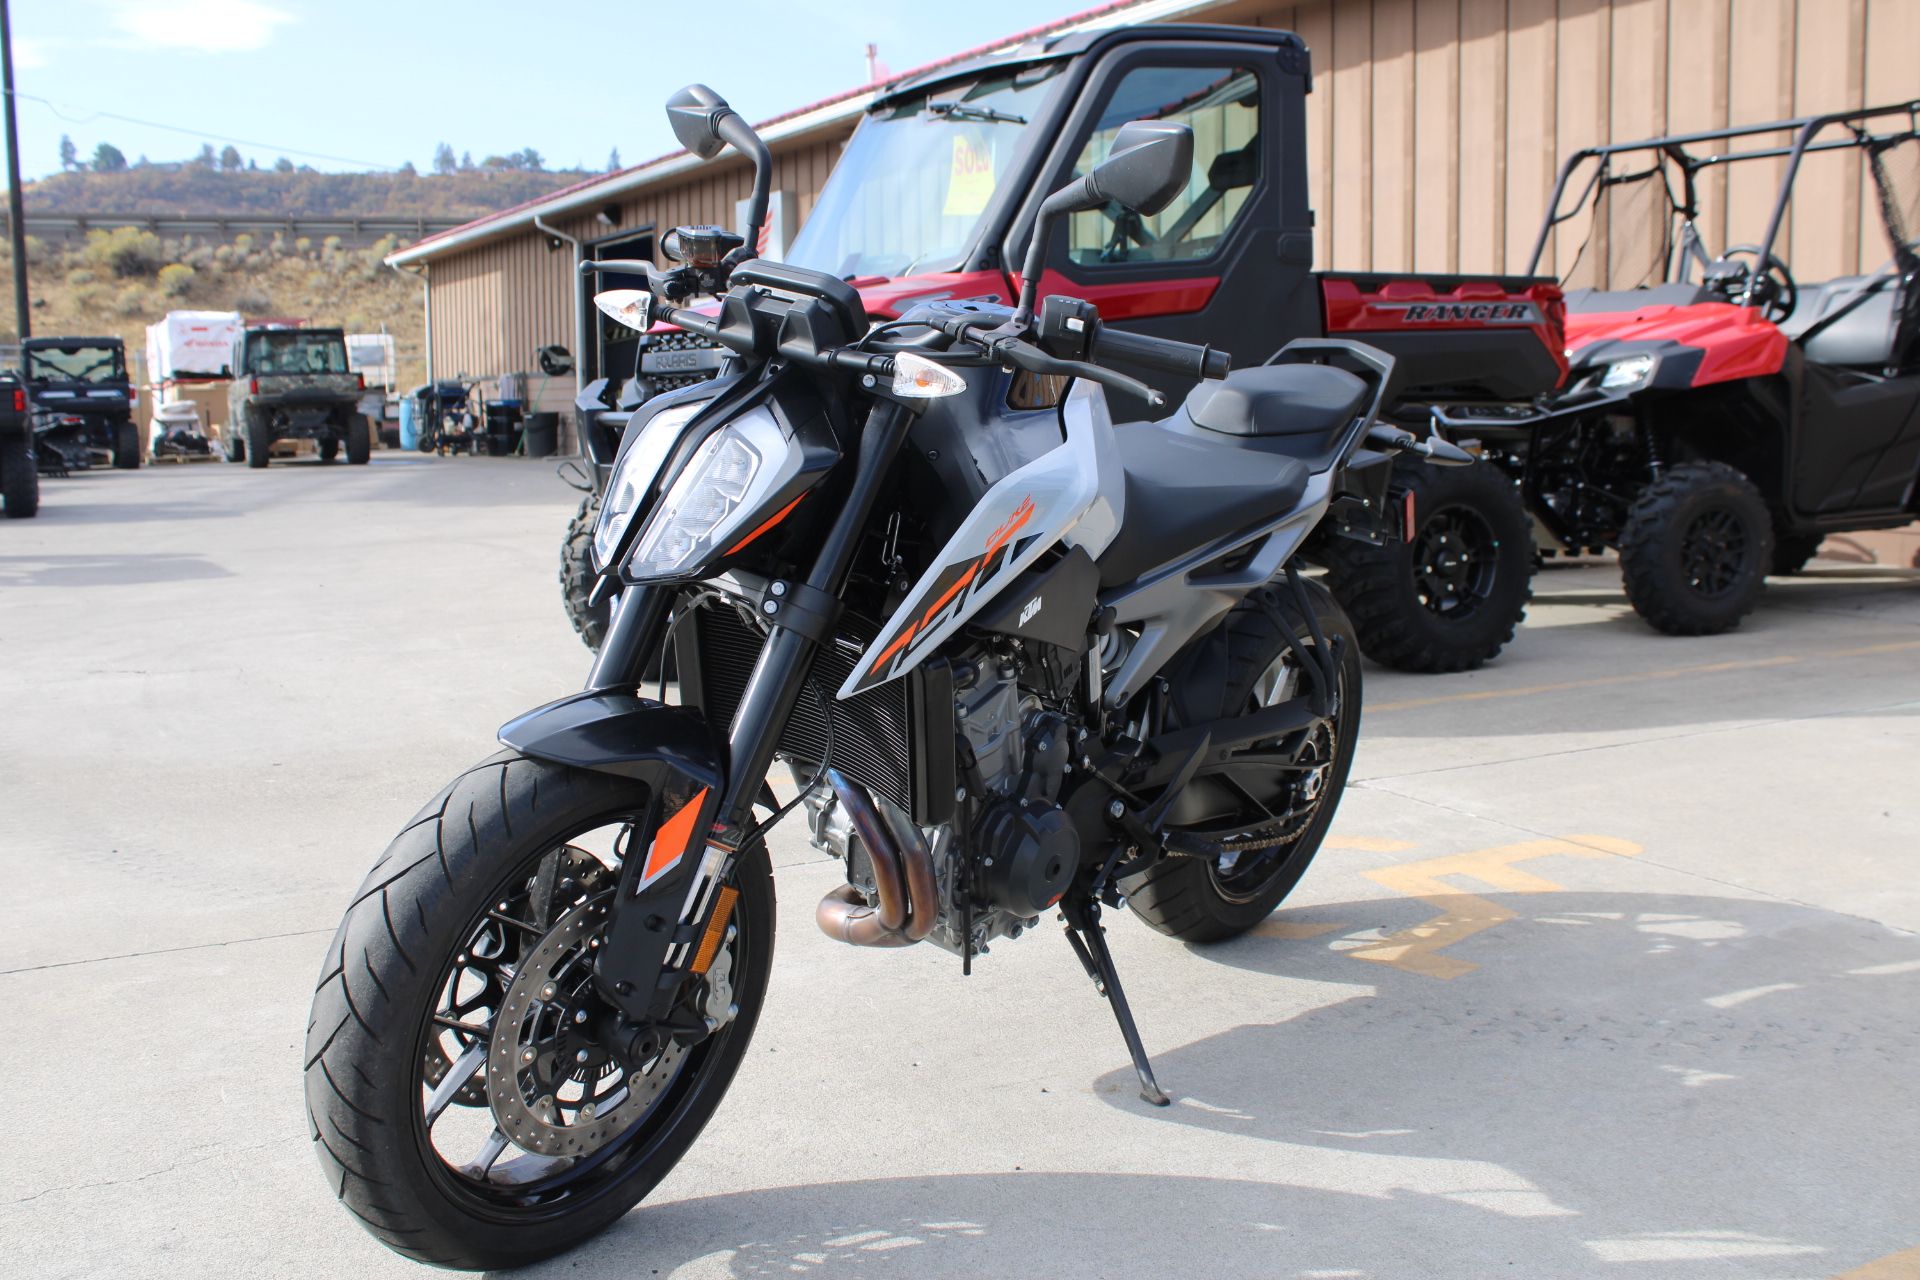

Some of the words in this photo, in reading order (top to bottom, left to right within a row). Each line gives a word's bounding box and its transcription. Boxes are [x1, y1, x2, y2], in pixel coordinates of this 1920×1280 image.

[1403, 304, 1530, 321] RANGER
[655, 352, 697, 369] POLARIS
[984, 492, 1031, 548] DUKE
[1018, 596, 1042, 628] KTM
